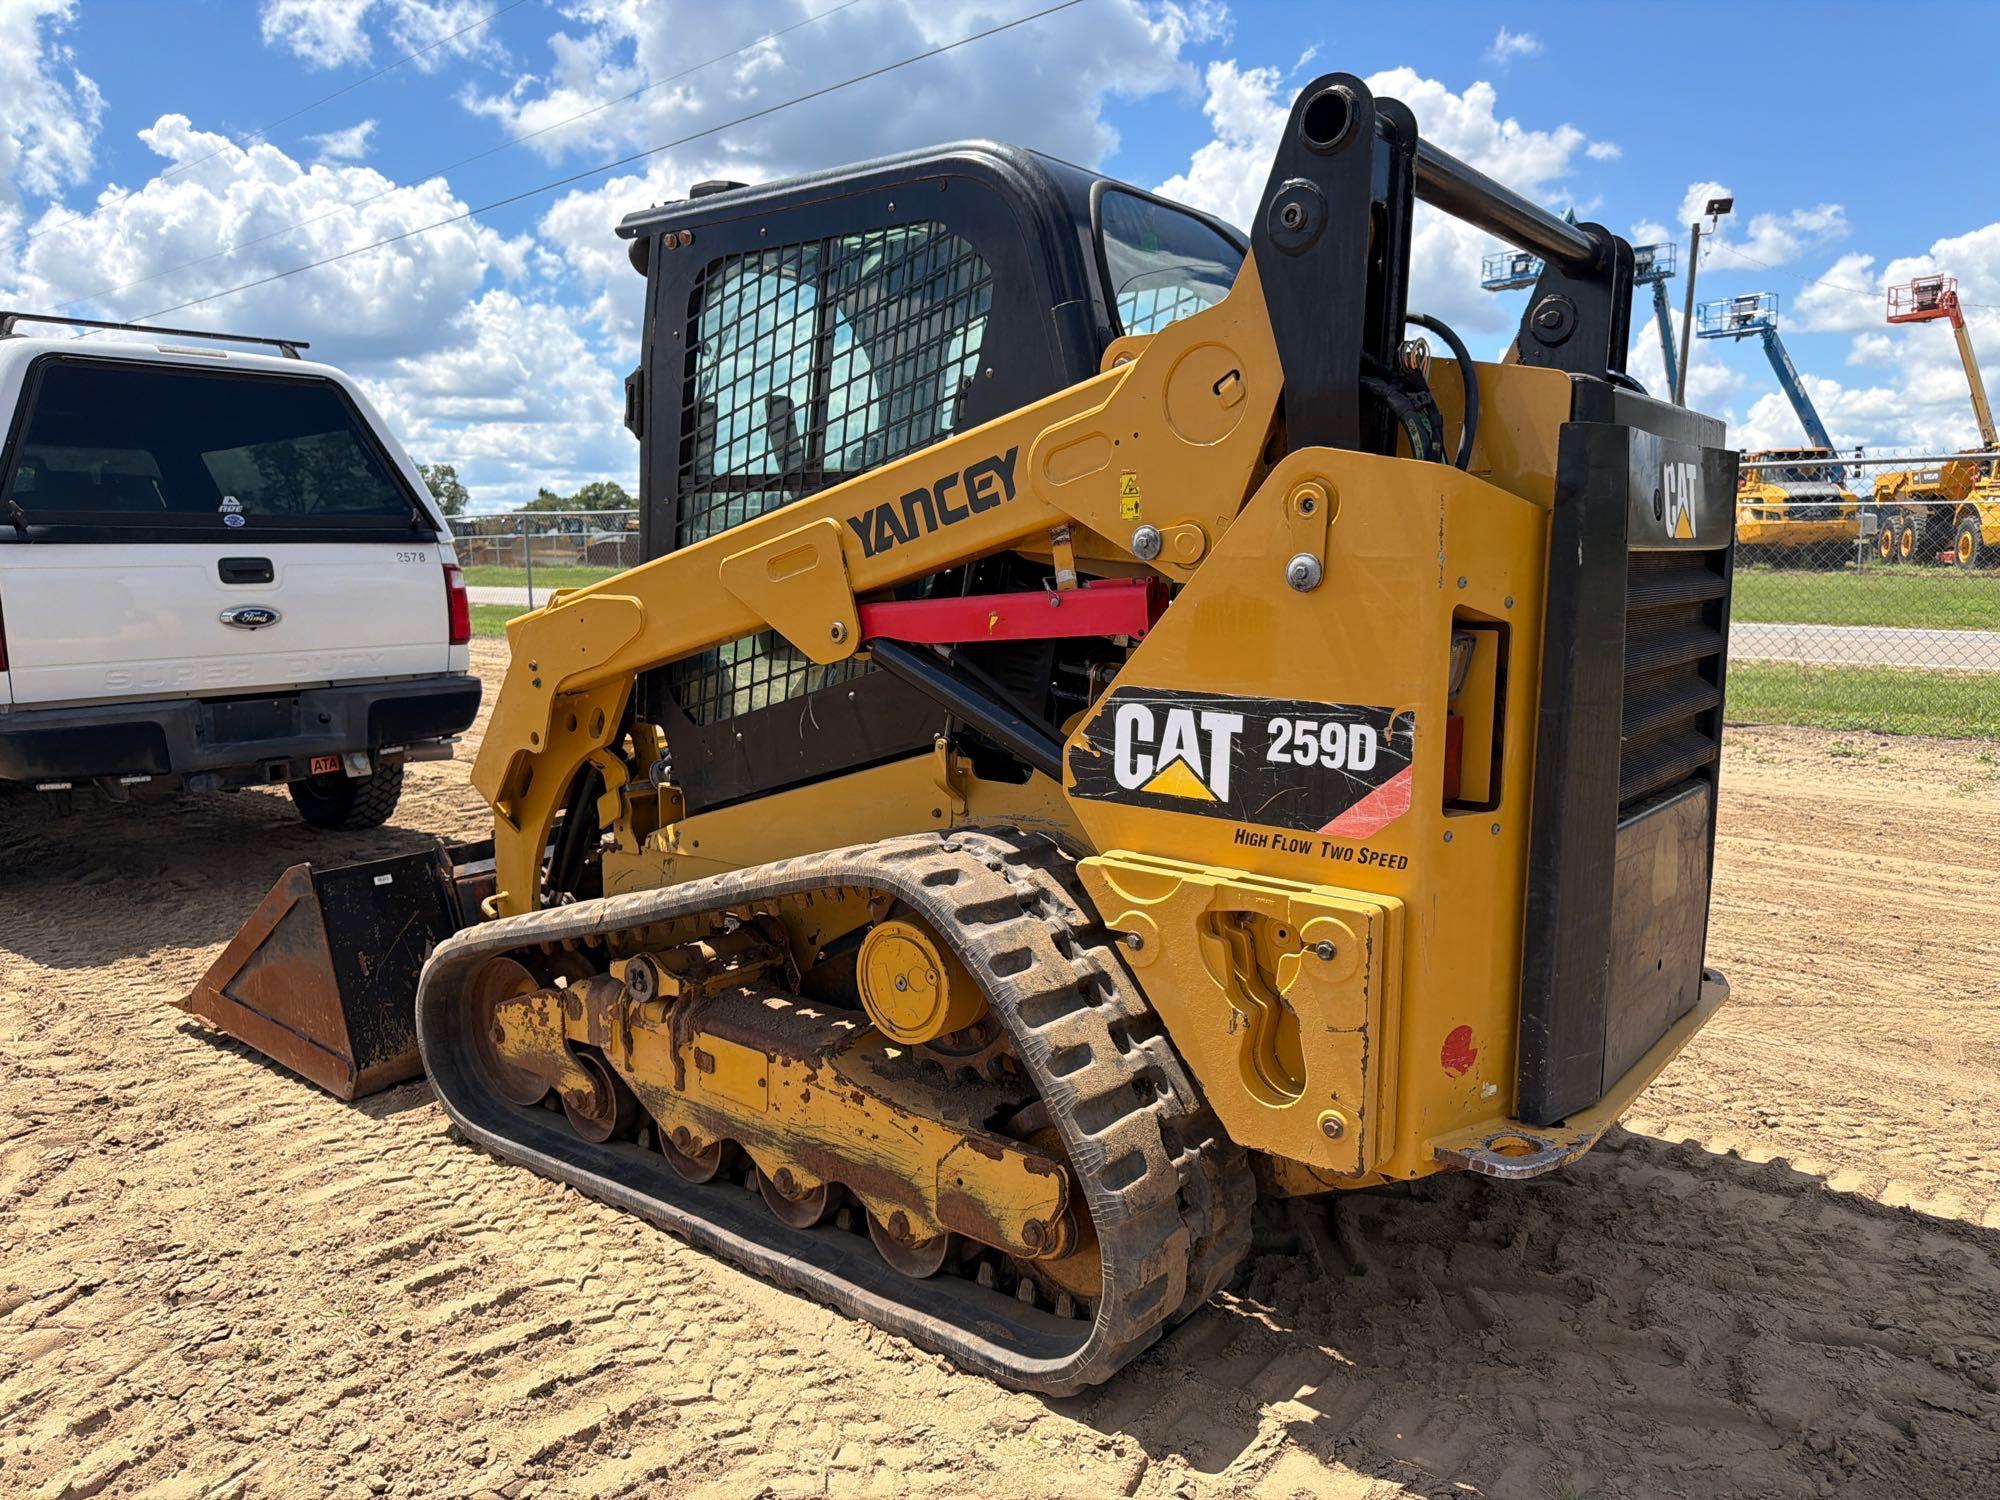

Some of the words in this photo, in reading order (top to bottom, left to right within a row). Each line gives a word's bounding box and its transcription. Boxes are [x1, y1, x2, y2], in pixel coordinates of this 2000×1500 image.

[847, 445, 1018, 558] YANCEY
[1664, 462, 1697, 538] CAT
[396, 551, 426, 562] 2578
[104, 660, 255, 690] SUPER
[284, 652, 385, 679] DUTY
[314, 758, 338, 773] ATA
[1114, 703, 1244, 802] CAT
[1266, 717, 1378, 772] 259D
